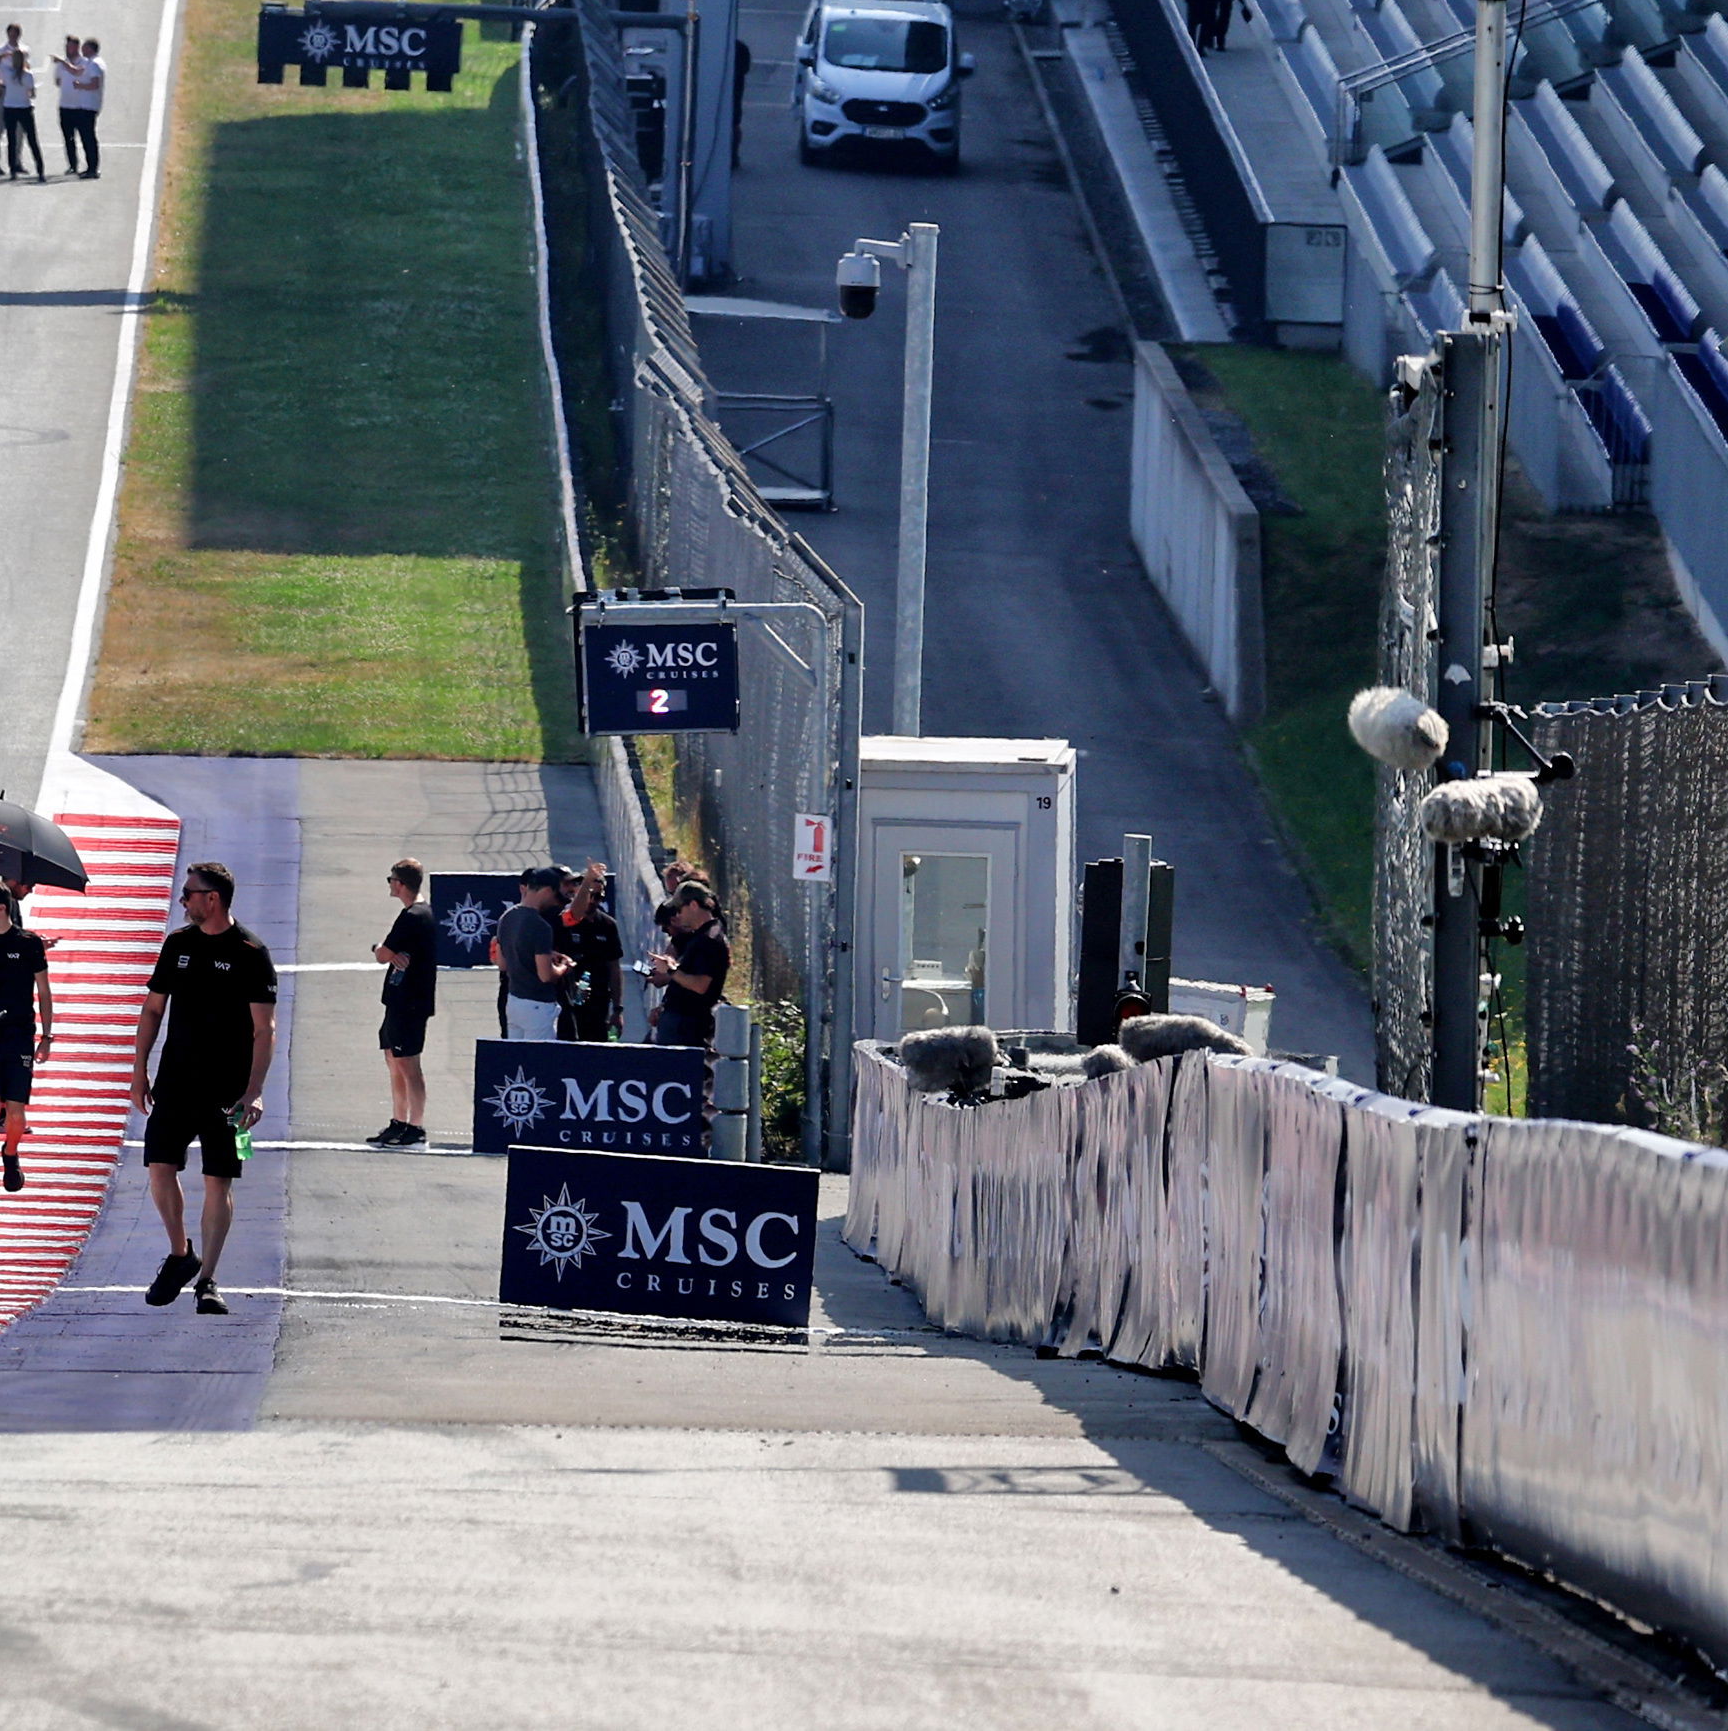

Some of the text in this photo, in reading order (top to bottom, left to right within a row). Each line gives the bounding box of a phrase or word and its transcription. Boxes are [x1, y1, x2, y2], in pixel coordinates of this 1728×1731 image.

[344, 25, 427, 57] MSC
[646, 642, 718, 667] MSC
[646, 670, 719, 680] CRUISES
[650, 689, 669, 713] 2
[1035, 796, 1052, 810] 19
[797, 853, 825, 863] FIRE
[214, 961, 231, 971] VAR
[559, 1077, 692, 1125] MSC
[559, 1129, 692, 1147] CRUISES
[617, 1200, 800, 1270] MSC
[616, 1271, 796, 1301] CRUISES
